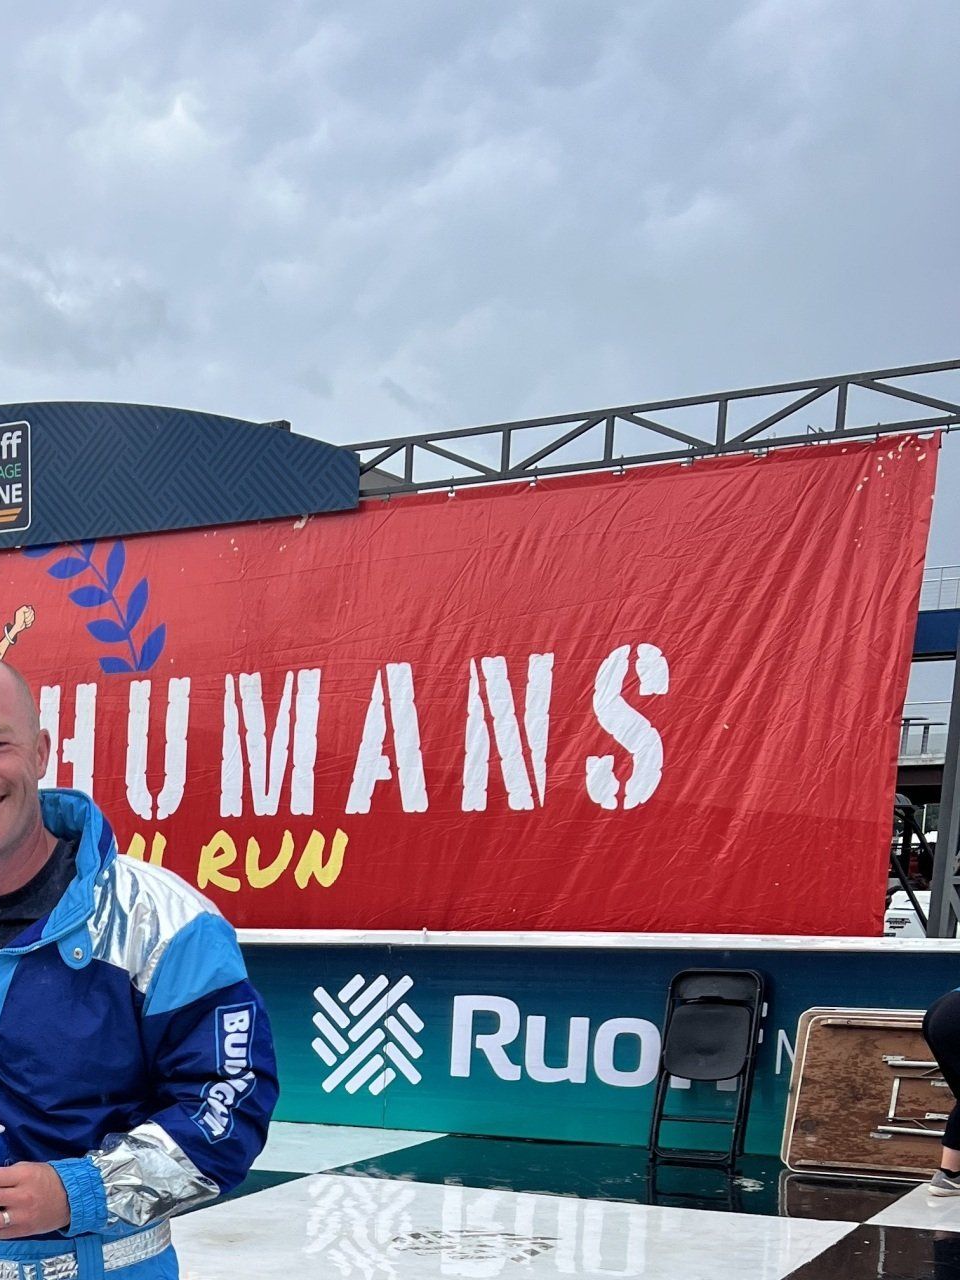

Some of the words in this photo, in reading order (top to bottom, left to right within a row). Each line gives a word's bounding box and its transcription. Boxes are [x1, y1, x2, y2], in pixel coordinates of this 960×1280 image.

[40, 643, 669, 820] HUMANS
[197, 828, 349, 892] RUN
[223, 1009, 250, 1075] BUD
[450, 993, 768, 1092] Ruo
